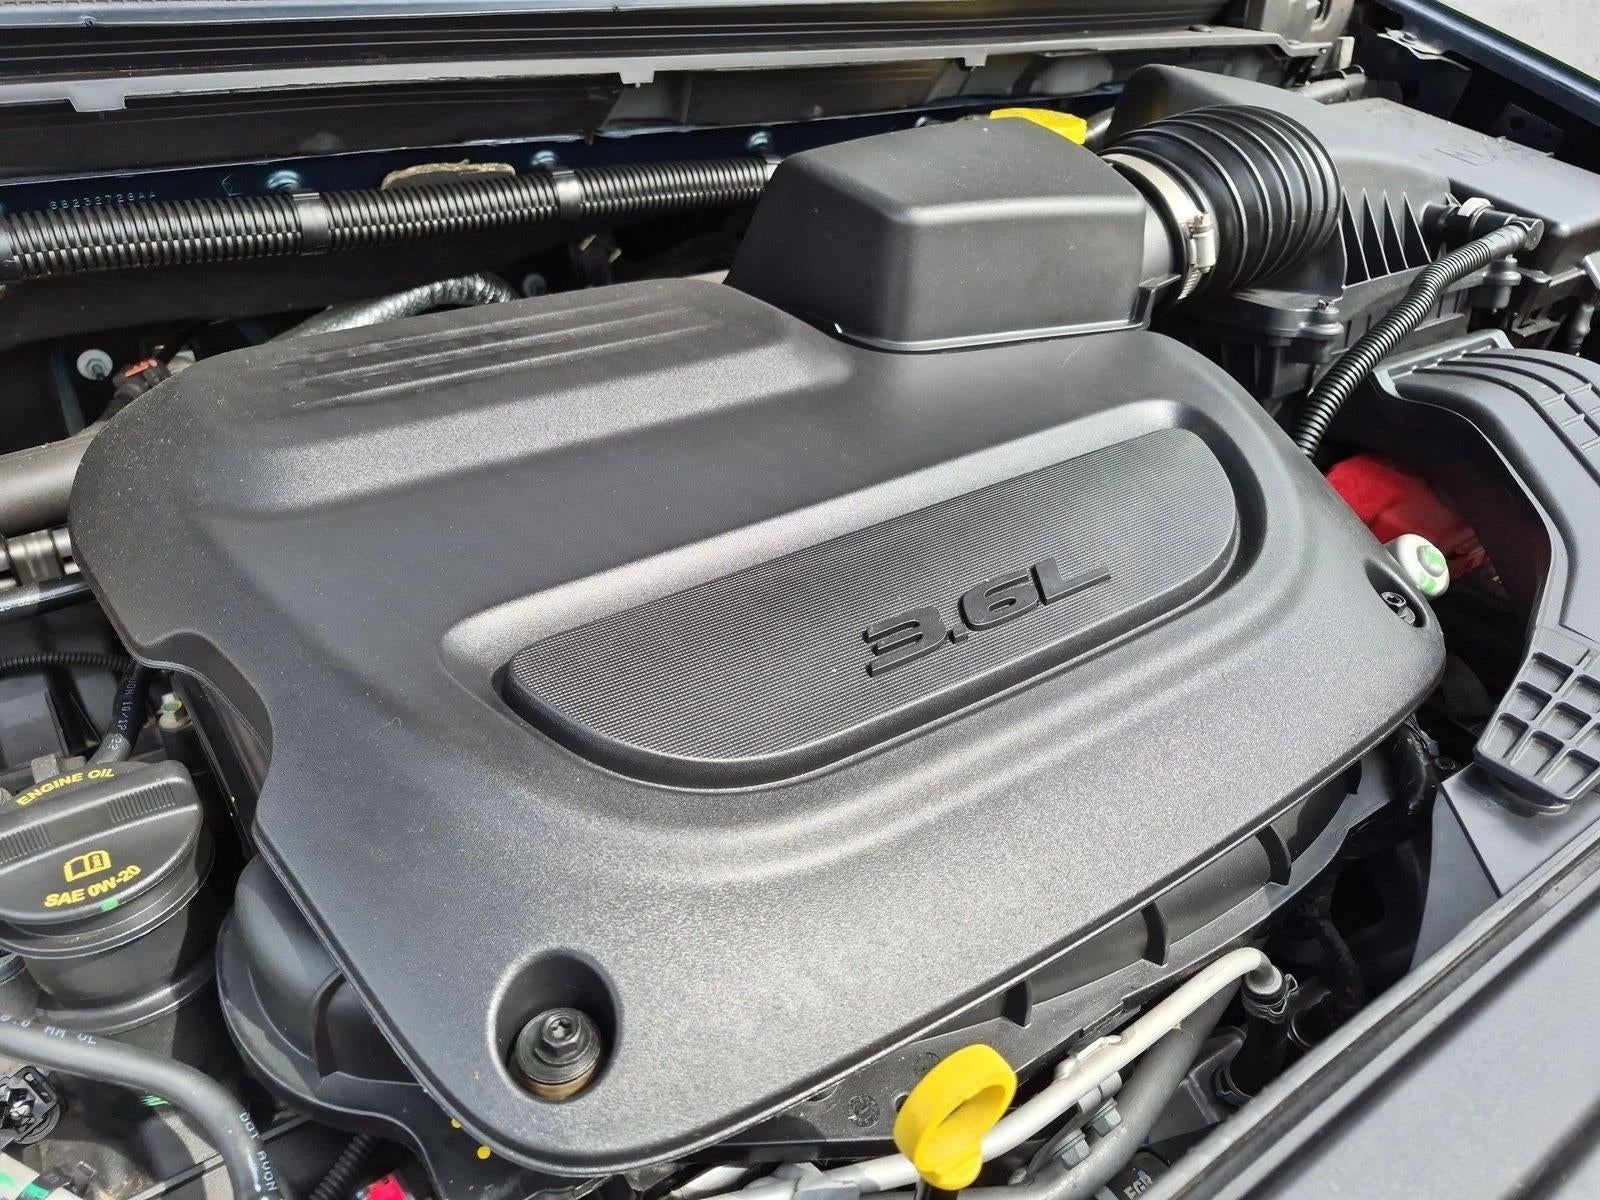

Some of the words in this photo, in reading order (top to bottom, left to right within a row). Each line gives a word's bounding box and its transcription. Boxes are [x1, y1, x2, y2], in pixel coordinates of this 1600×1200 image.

[861, 556, 1112, 678] 3.6L
[16, 772, 84, 807] ENGINE
[88, 768, 115, 779] OIL
[44, 889, 86, 908] SAE
[87, 865, 142, 897] 0W-20
